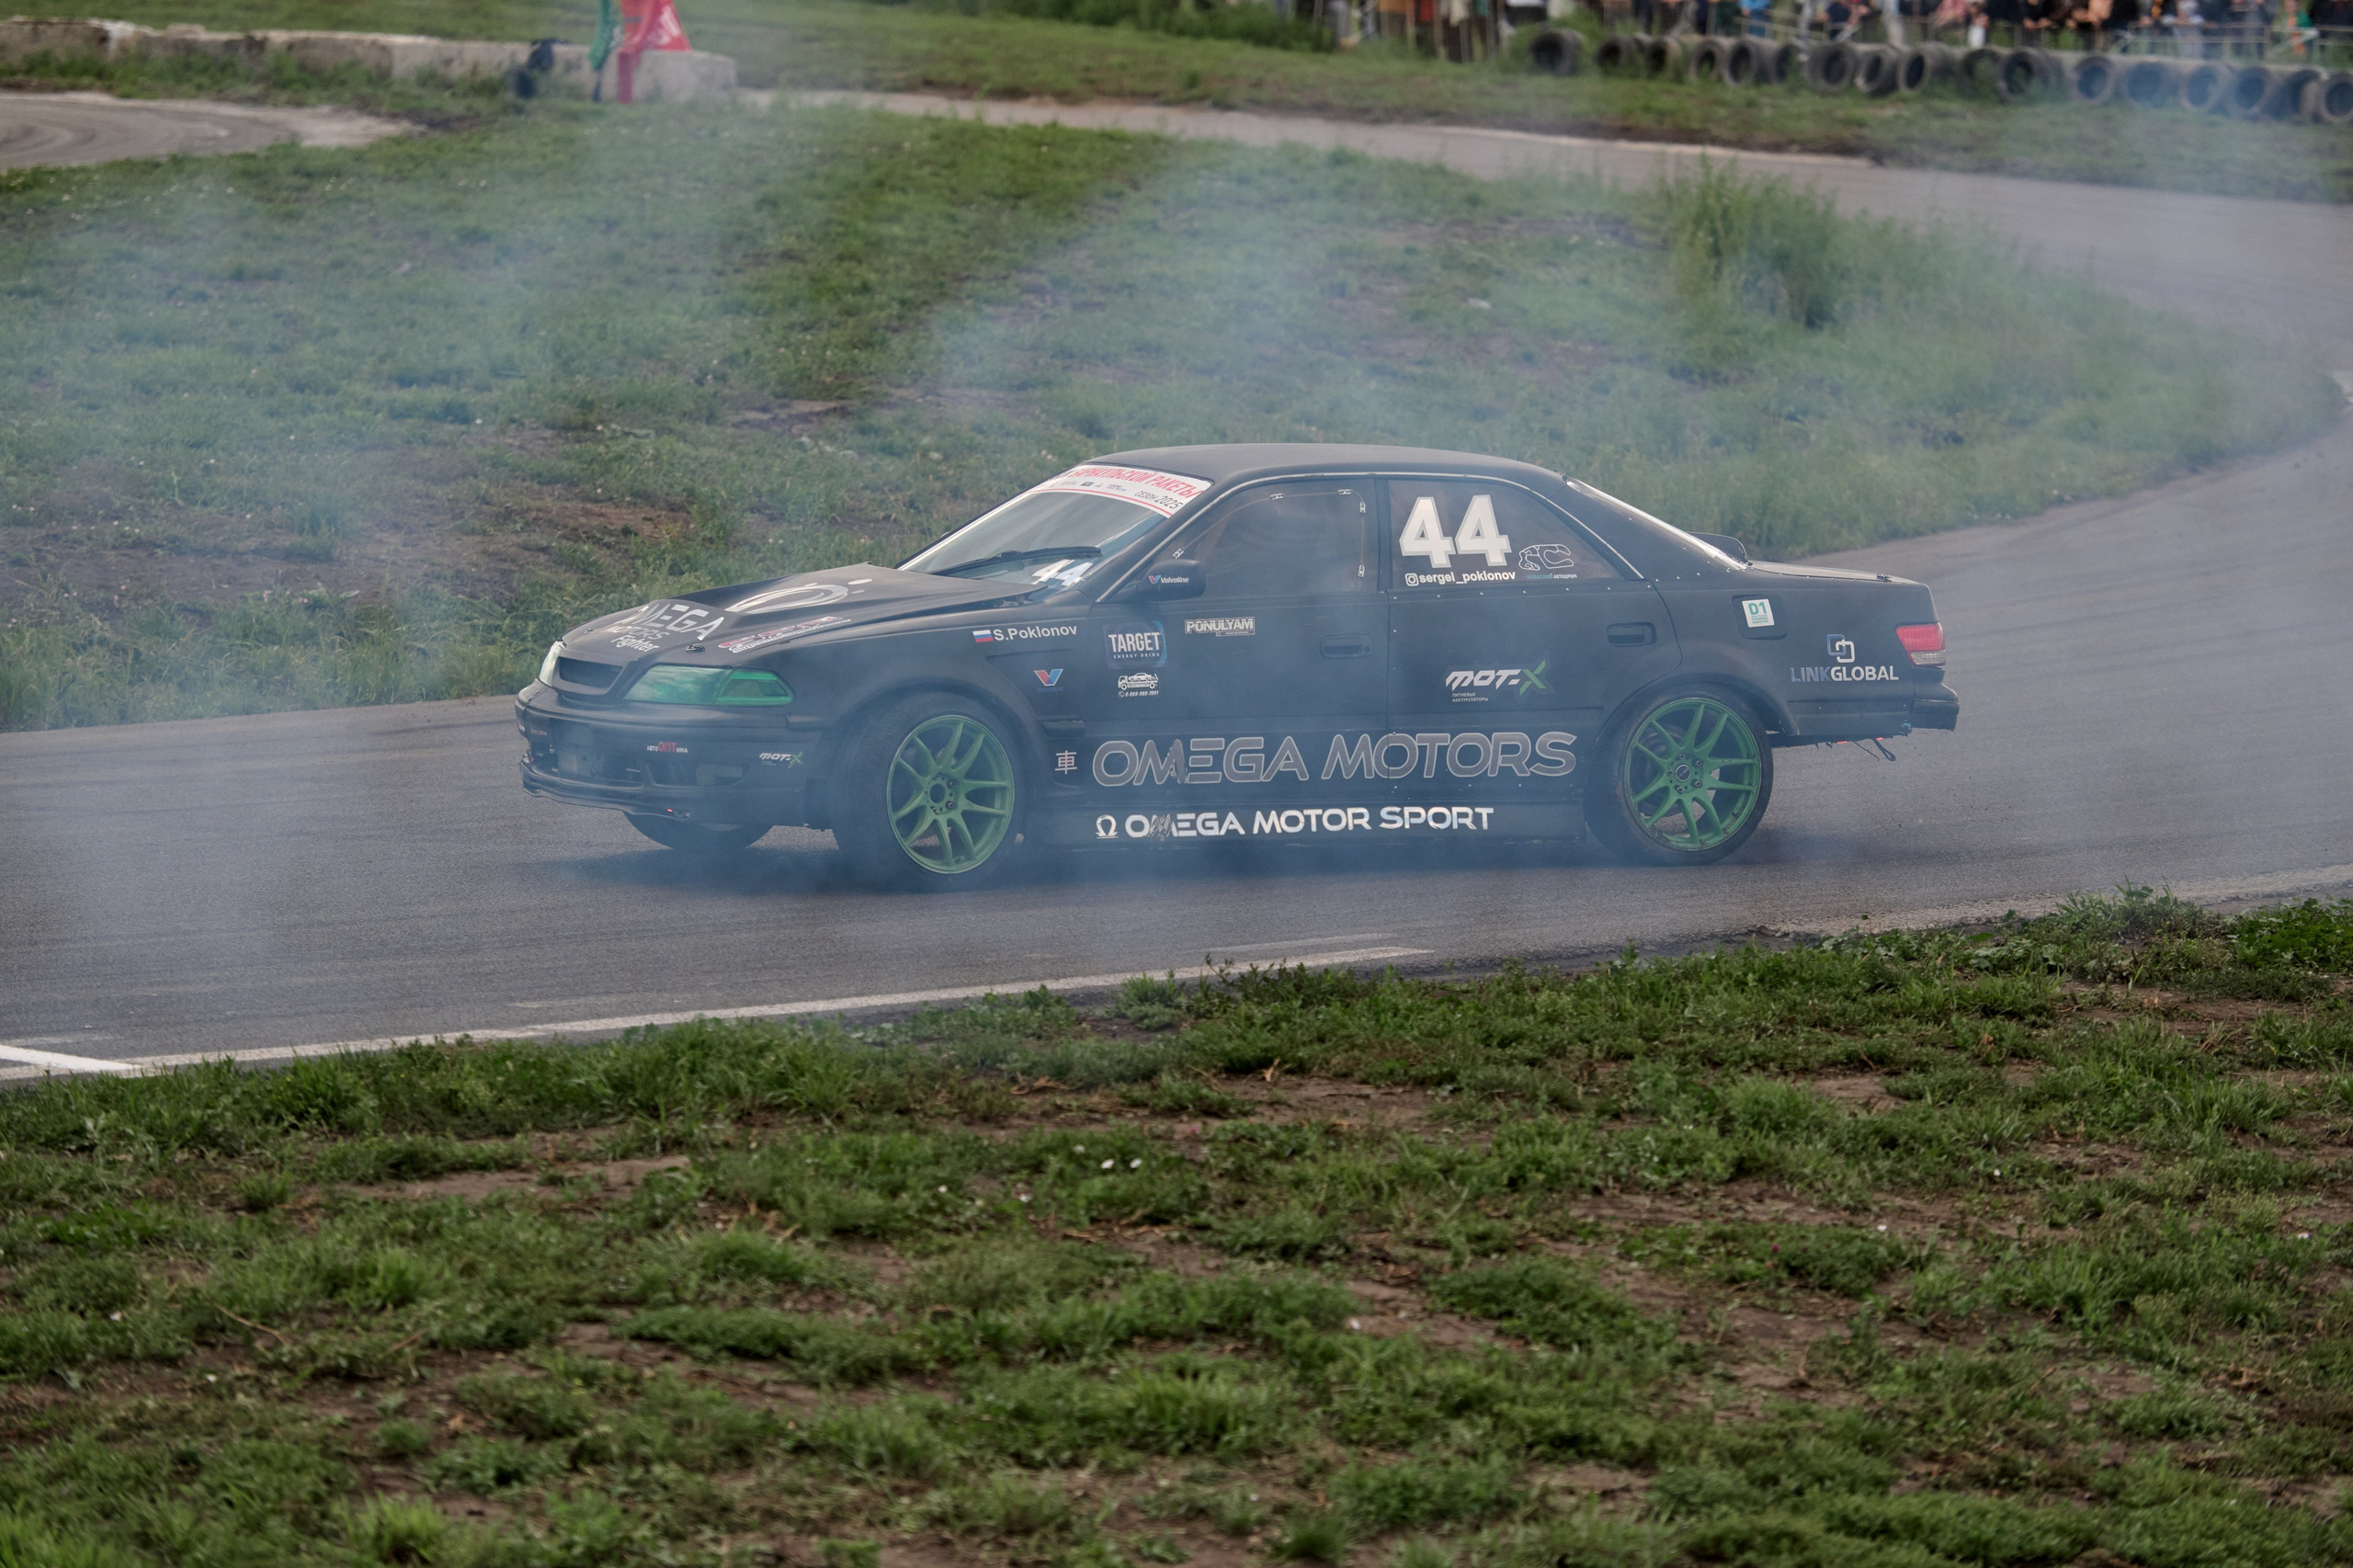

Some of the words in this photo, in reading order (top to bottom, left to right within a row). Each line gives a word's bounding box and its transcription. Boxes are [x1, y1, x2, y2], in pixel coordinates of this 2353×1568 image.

[1144, 475, 1204, 498] РАКЕТЫ
[1154, 495, 1184, 509] 2025
[1399, 494, 1513, 569] 44
[1031, 559, 1094, 587] 44
[1161, 575, 1189, 585] Valvoline
[1418, 571, 1516, 585] sergei_poklonov
[1748, 601, 1767, 615] D1
[993, 626, 1077, 642] S.Poklonov
[1186, 618, 1254, 632] PONULYAM
[610, 634, 660, 653] Fighter
[1108, 632, 1160, 653] TARGET
[1055, 750, 1077, 774] 車
[1092, 735, 1309, 787] OMEGA
[1322, 732, 1578, 779] MOTORS
[1253, 808, 1372, 835] MOTOR
[1379, 806, 1495, 830] SPORT
